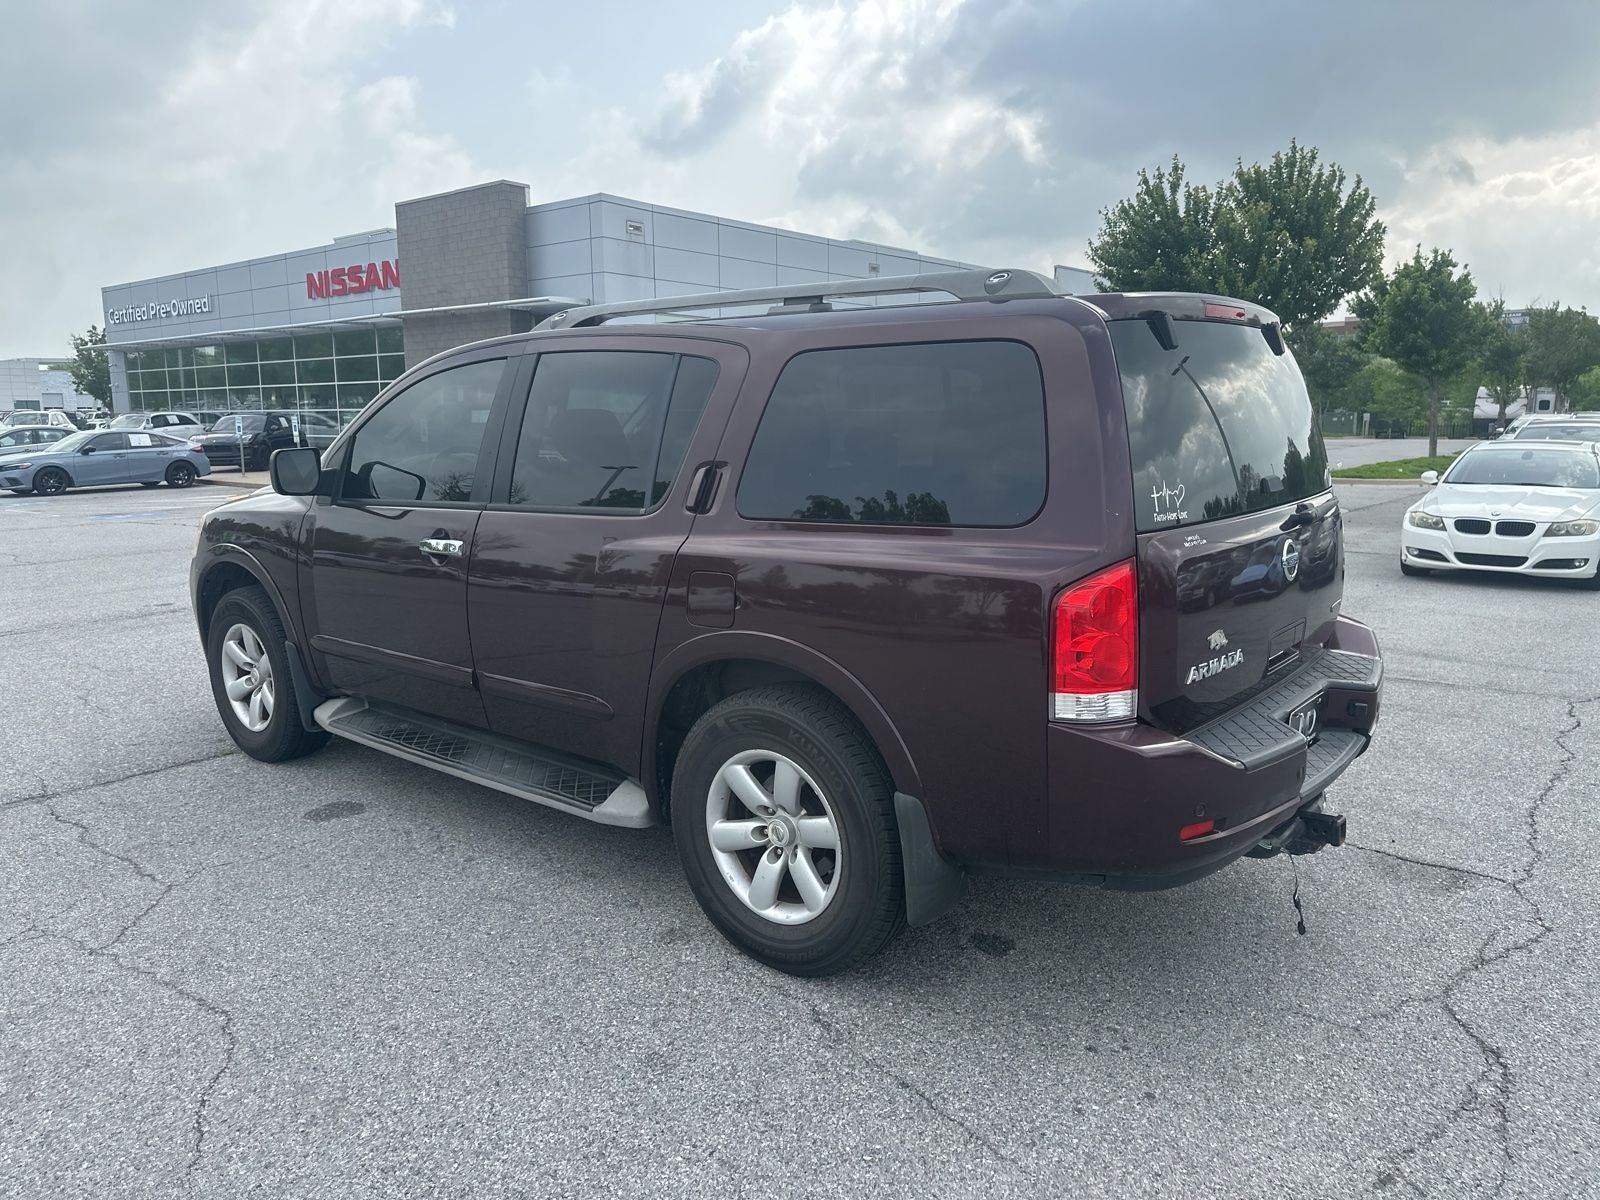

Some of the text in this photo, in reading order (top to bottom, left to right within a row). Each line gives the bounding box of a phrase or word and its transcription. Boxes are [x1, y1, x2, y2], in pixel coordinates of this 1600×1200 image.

[306, 258, 400, 299] NISSAN
[108, 292, 209, 324] Certified Pre-Owned
[1186, 648, 1244, 685] ARMADA
